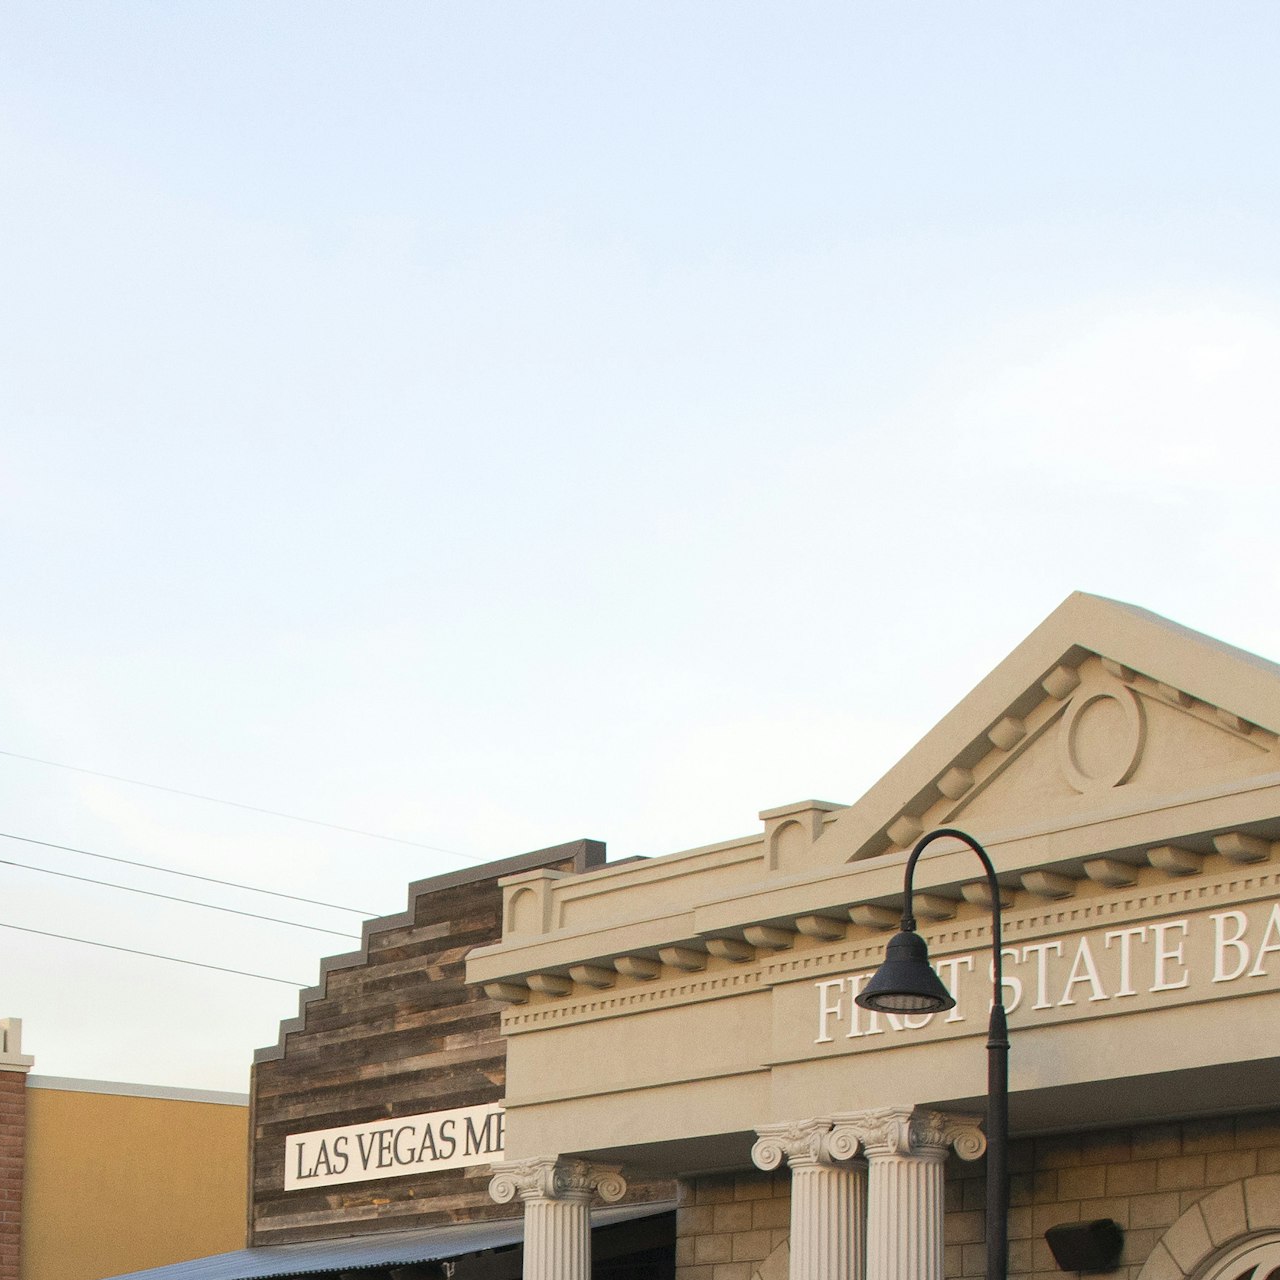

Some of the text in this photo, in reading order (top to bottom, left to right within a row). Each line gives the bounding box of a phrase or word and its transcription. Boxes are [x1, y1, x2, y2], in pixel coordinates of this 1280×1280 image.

[988, 918, 1190, 1015] STATE
[296, 1136, 349, 1179] LAS
[356, 1120, 457, 1171] VEGAS
